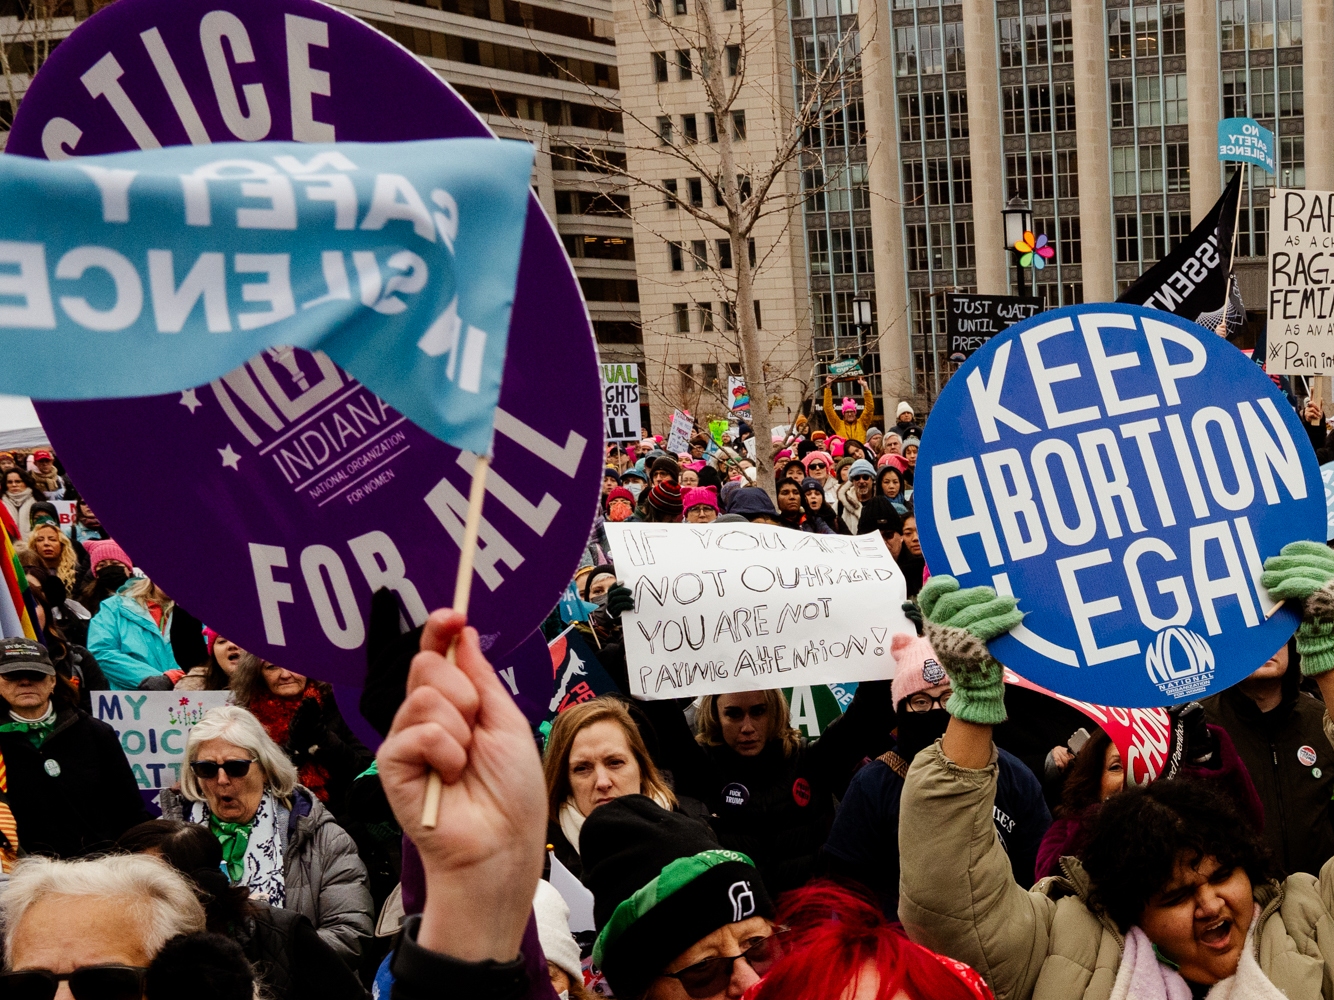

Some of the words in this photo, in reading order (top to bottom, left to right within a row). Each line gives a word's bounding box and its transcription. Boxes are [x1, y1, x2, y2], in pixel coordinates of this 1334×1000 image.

[1285, 235, 1300, 247] AS
[1310, 236, 1317, 248] A
[953, 298, 992, 314] JUST
[997, 303, 1039, 319] WAIT
[958, 318, 998, 332] UNTIL
[1285, 323, 1300, 336] AS
[1307, 324, 1322, 336] AN
[601, 364, 638, 384] UAL
[966, 313, 1207, 444] KEEP
[604, 384, 639, 404] GHTS
[606, 404, 629, 416] FOR
[309, 471, 348, 499] NATIONAL
[346, 431, 406, 475] ORGANIZATION
[346, 488, 366, 505] FOR
[362, 468, 396, 496] WOMEN
[931, 397, 1308, 577] ABORTION
[622, 528, 668, 567] IF
[690, 527, 787, 552] YOU
[792, 534, 884, 559] ARE
[248, 530, 429, 650] FOR
[633, 568, 728, 615] NOT
[637, 614, 706, 655] YOU
[713, 604, 770, 643] ARE
[776, 597, 833, 634] NOT
[1145, 628, 1215, 684] NOW
[1159, 673, 1214, 690] NATIONAL
[1166, 680, 1211, 695] ORGANIZATION
[98, 694, 148, 721] MY
[115, 728, 191, 755] OIC
[725, 796, 744, 805] TRUMP
